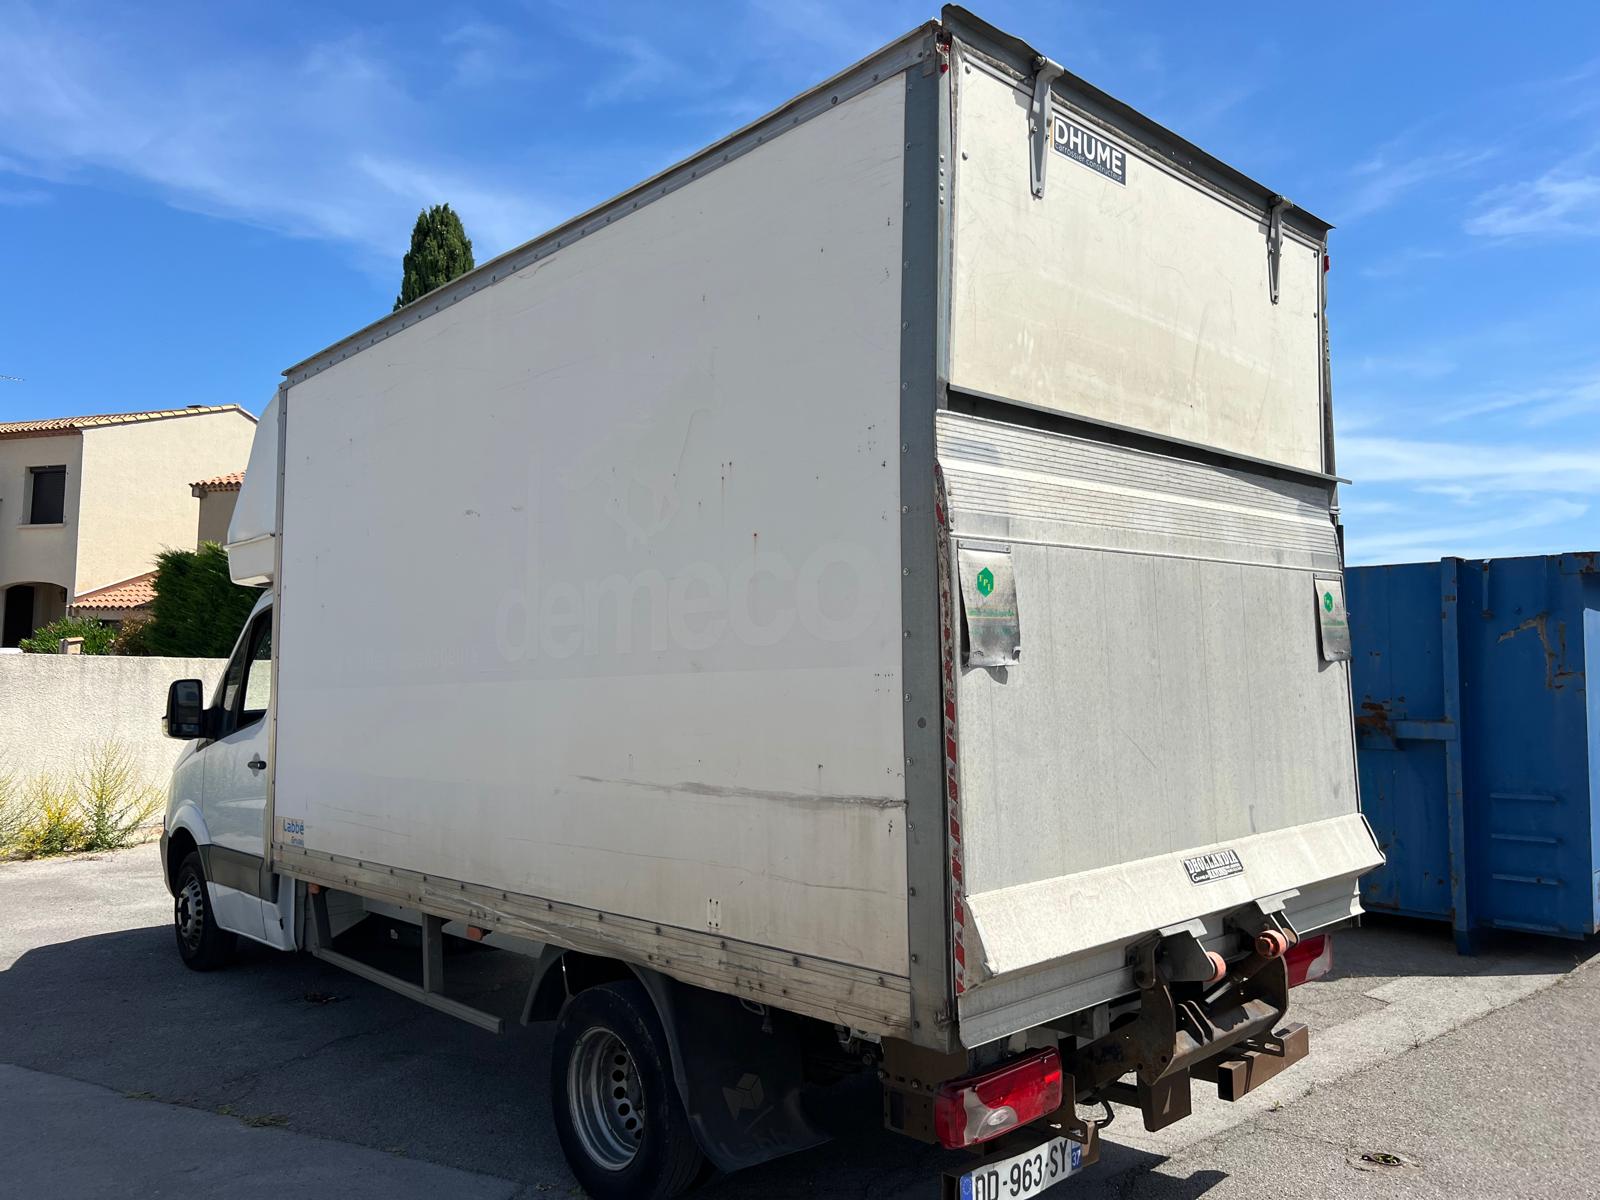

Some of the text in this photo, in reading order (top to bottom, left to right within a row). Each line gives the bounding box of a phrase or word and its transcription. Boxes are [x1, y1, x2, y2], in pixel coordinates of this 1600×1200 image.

[1055, 118, 1122, 175] DHUME
[1055, 143, 1085, 162] carrossier
[494, 452, 884, 664] demeco
[1185, 849, 1239, 874] DHOLLANDIA
[1071, 1150, 1081, 1167] 37
